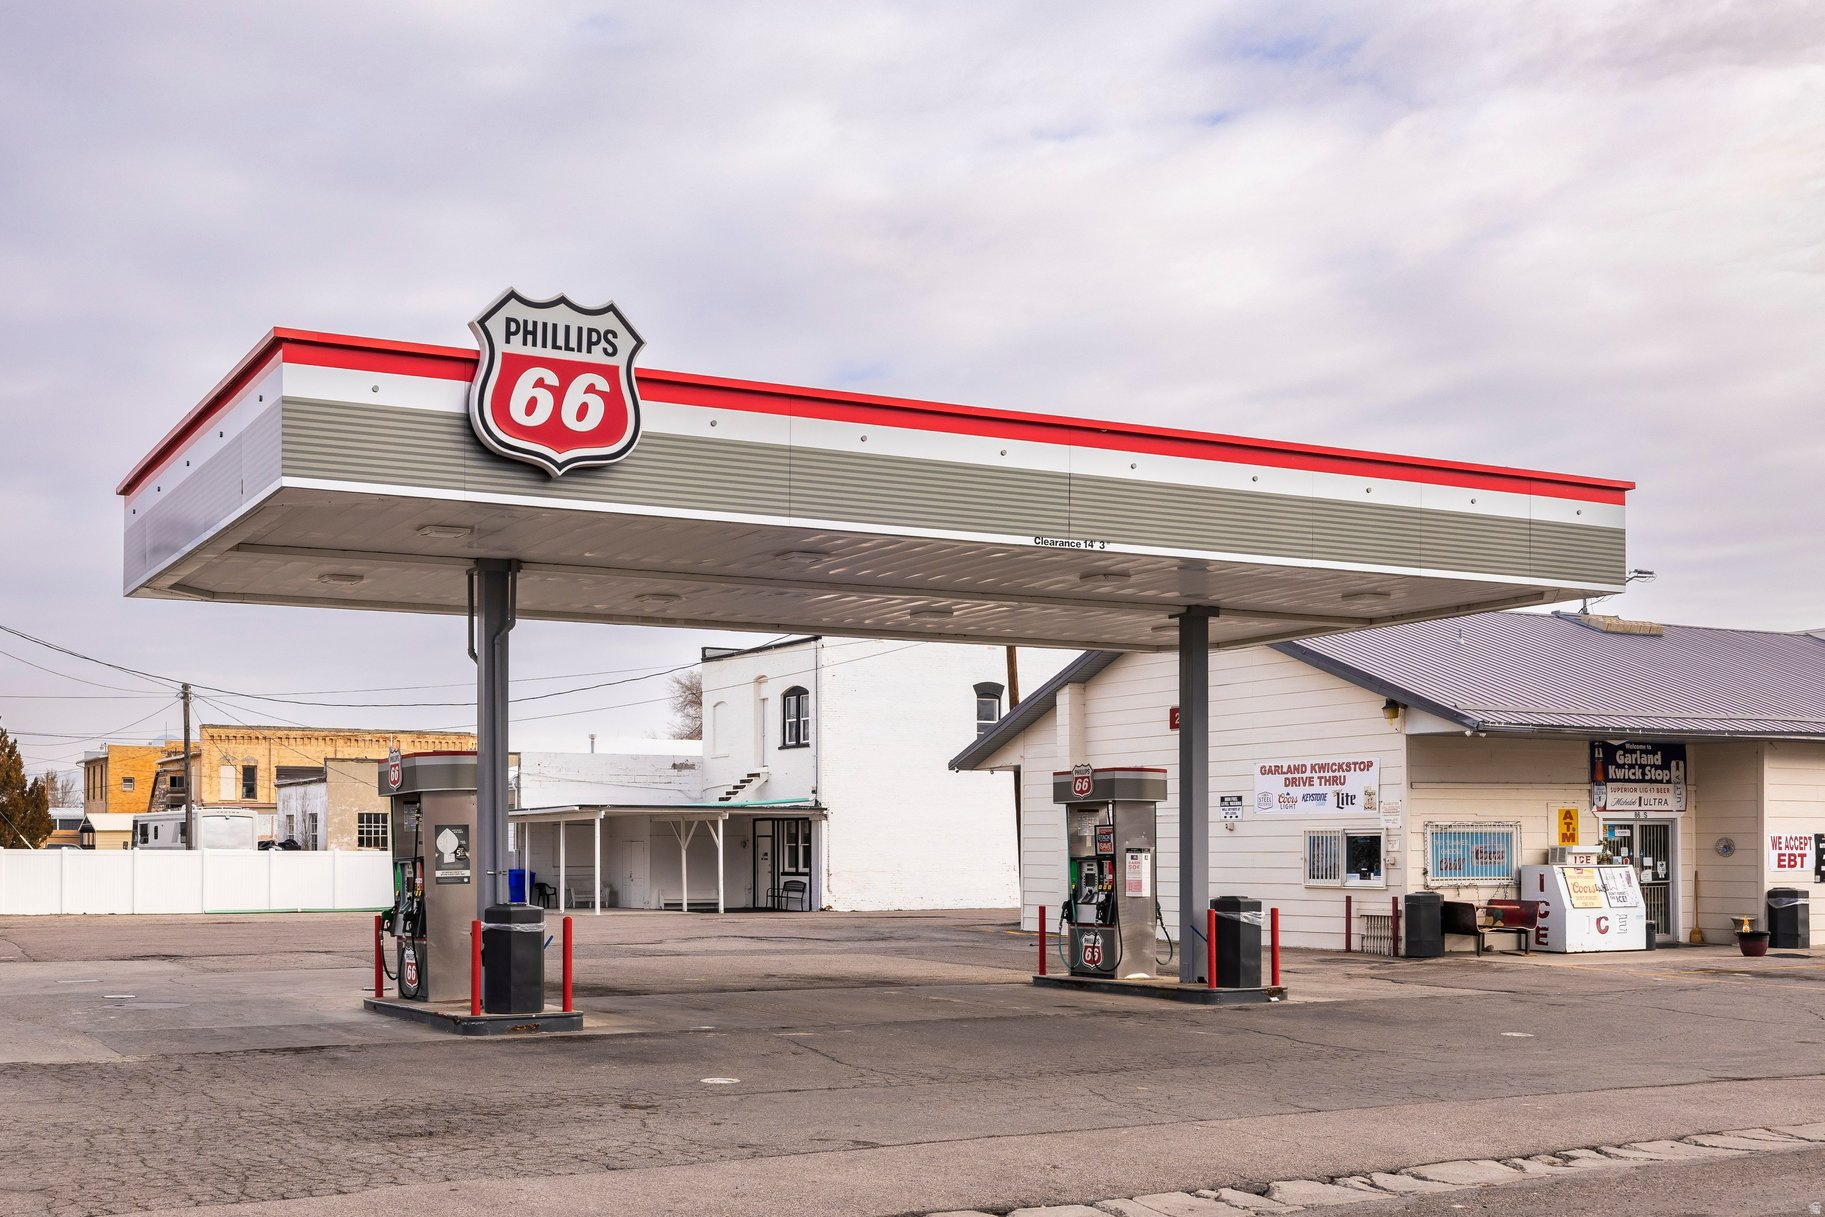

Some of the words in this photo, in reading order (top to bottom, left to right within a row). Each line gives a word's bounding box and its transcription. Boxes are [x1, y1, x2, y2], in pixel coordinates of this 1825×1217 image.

[504, 316, 618, 358] PHILLIPS
[509, 366, 611, 432] 66
[1033, 536, 1082, 549] Clearance
[1615, 750, 1662, 765] Garland
[390, 765, 399, 782] 66
[1260, 764, 1307, 776] GARLAND
[1310, 760, 1374, 774] KWICKSTOP
[1608, 764, 1642, 780] Kwick
[1644, 765, 1671, 783] Stop
[1075, 778, 1089, 791] 66
[1284, 776, 1315, 788] DRIVE
[1317, 775, 1347, 787] THRU
[1277, 792, 1299, 804] Coors
[1301, 792, 1328, 802] KEYSTONE
[1336, 792, 1356, 810] Lite
[1643, 797, 1669, 806] ULTRA
[1561, 809, 1576, 843] ATM
[1770, 835, 1783, 851] WE
[1784, 835, 1813, 851] ACCEPT
[1574, 855, 1591, 864] ICE
[1777, 852, 1807, 869] EBT
[1571, 881, 1596, 894] Coors
[1085, 947, 1099, 961] 66
[406, 964, 417, 981] 66
